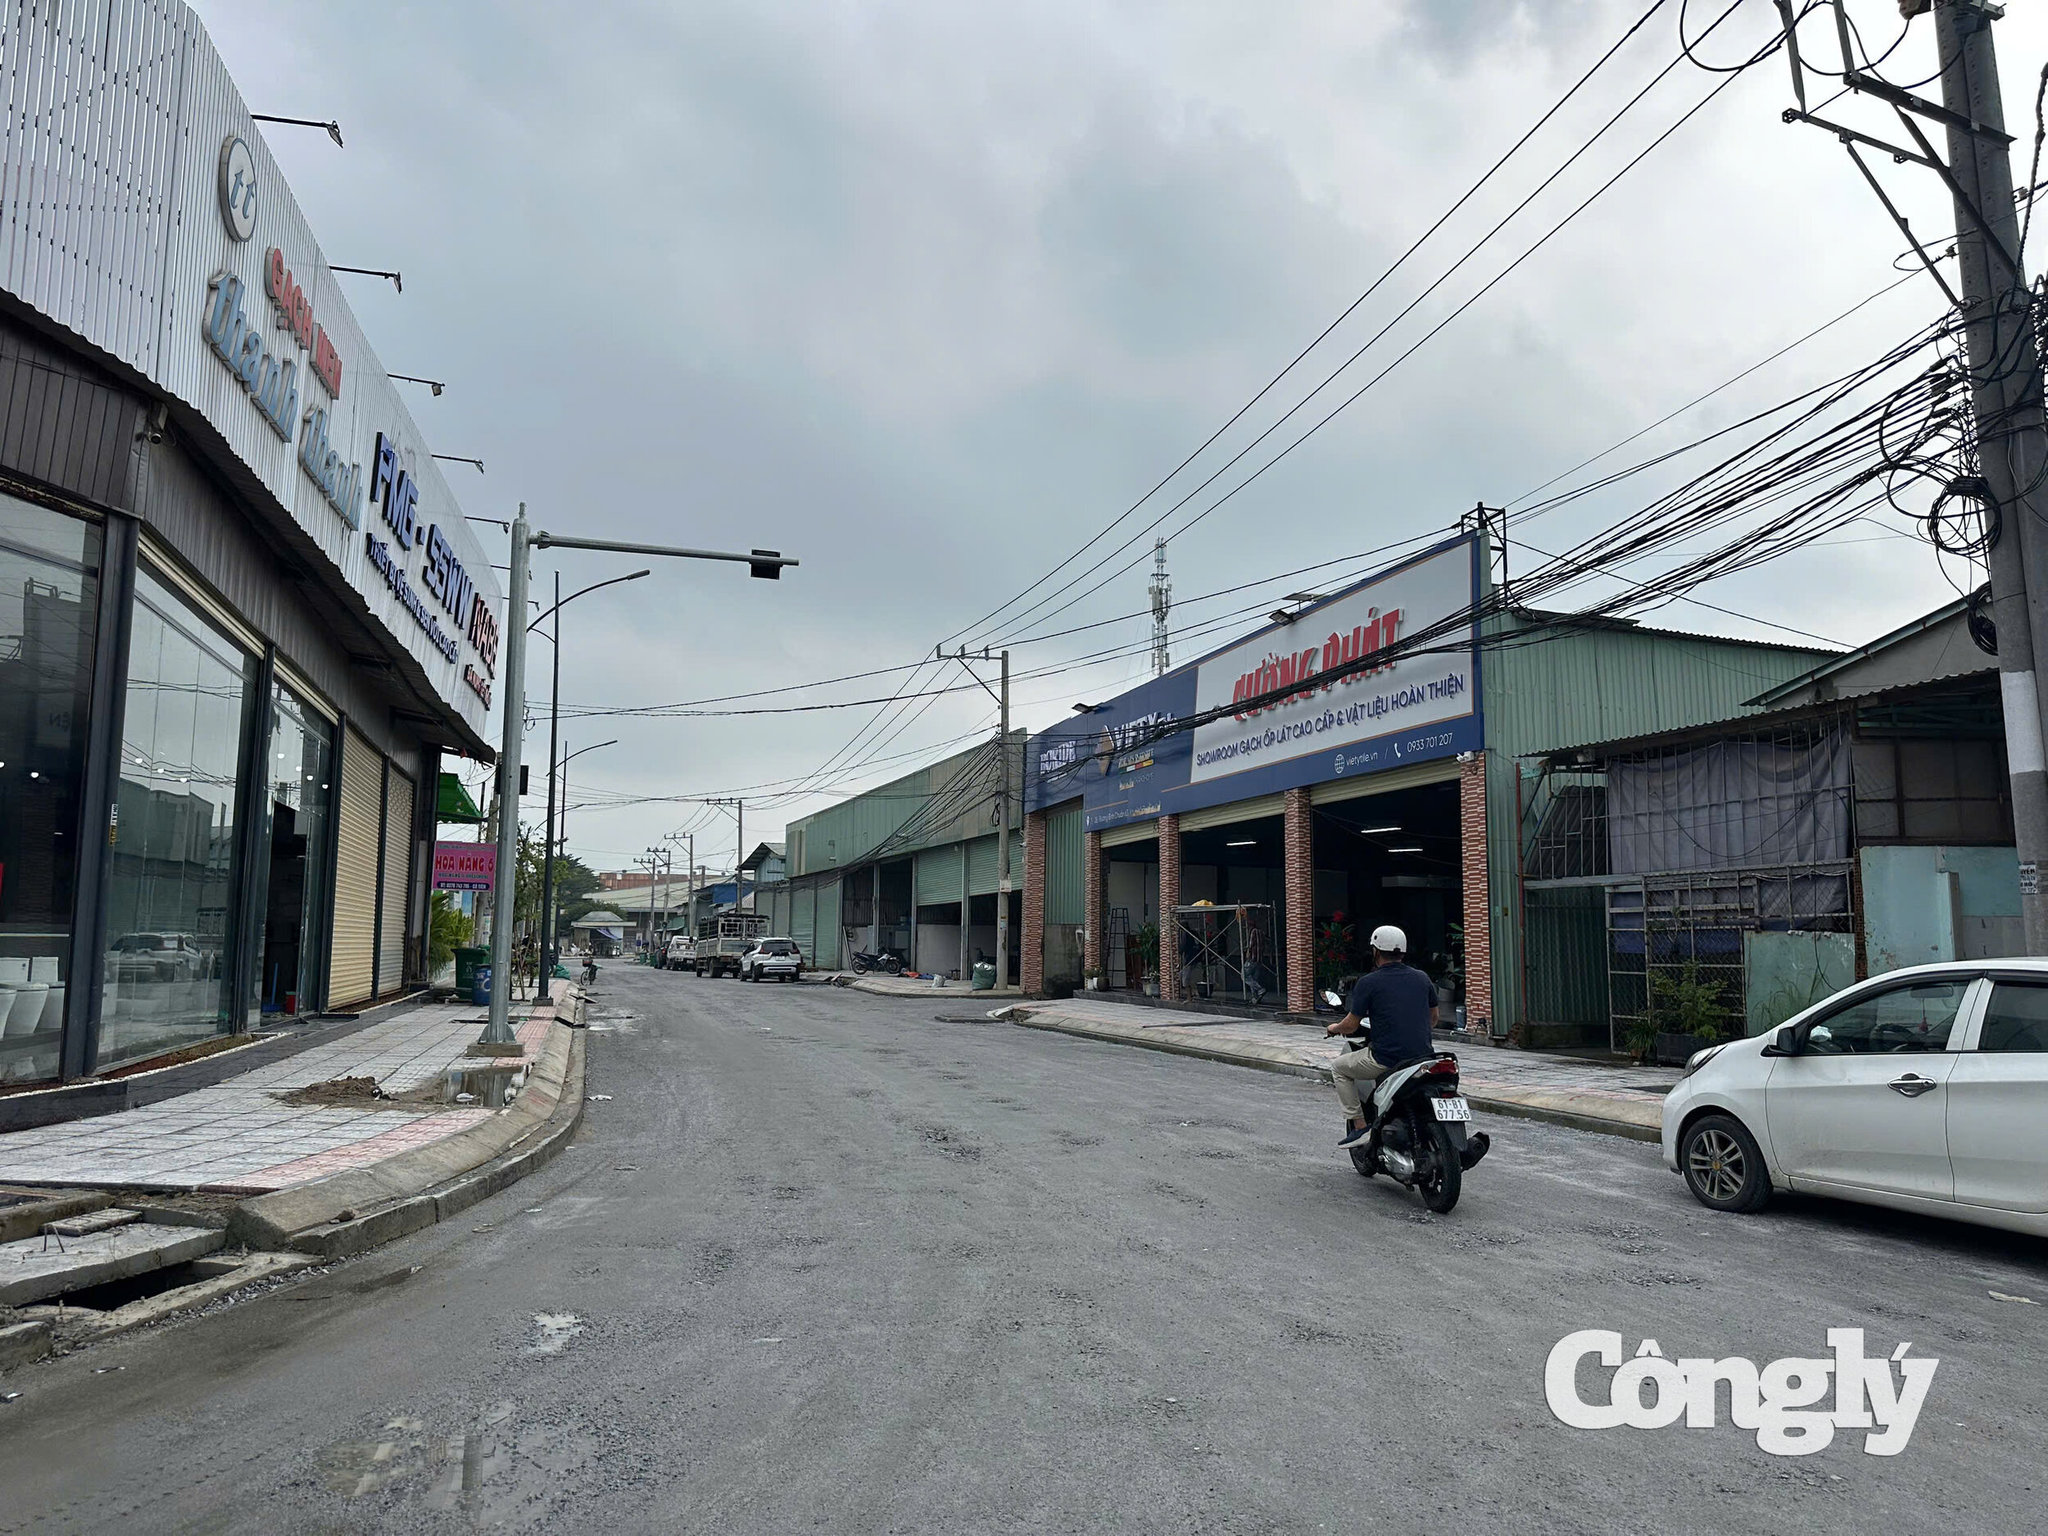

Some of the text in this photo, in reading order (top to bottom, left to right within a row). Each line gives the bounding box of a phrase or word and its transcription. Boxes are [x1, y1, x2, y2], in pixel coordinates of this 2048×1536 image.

[266, 247, 343, 400] GẠCH MEN
[203, 268, 363, 531] thanh thanh
[422, 523, 475, 630] SSWW
[1321, 607, 1403, 691] PHÁT
[1196, 673, 1464, 766] SHOWROOM GẠCH ỐP LÁT CAO CẤP & VẬT LIỆU HOÀN THIỆN
[1406, 738, 1425, 753] 0933
[1426, 736, 1438, 749] 701
[1438, 732, 1454, 746] 207
[435, 855, 455, 870] HOA
[1437, 1109, 1470, 1120] 677.56
